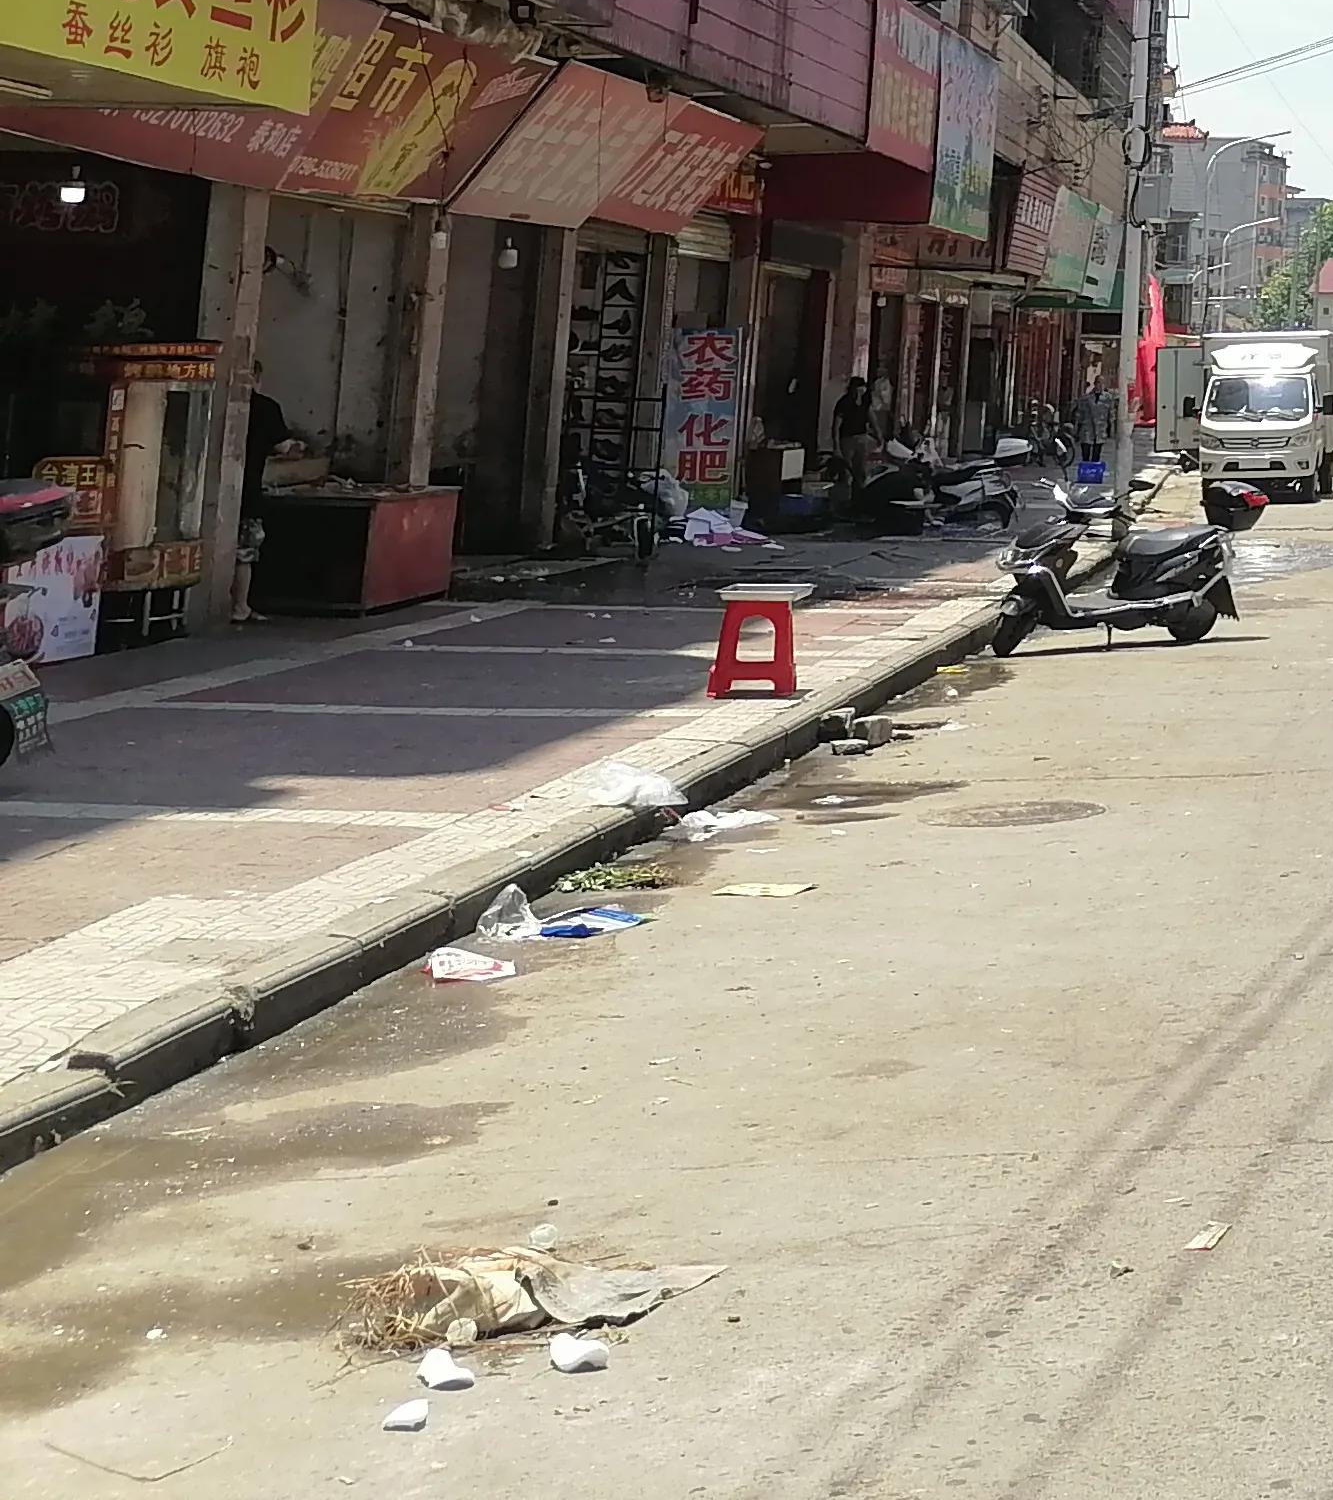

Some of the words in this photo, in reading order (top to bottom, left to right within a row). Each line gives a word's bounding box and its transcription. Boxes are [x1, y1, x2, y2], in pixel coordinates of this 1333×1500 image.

[62, 0, 173, 67] 蚕丝衫
[200, 36, 261, 90] 旗袍
[674, 332, 738, 486] 农药化肥
